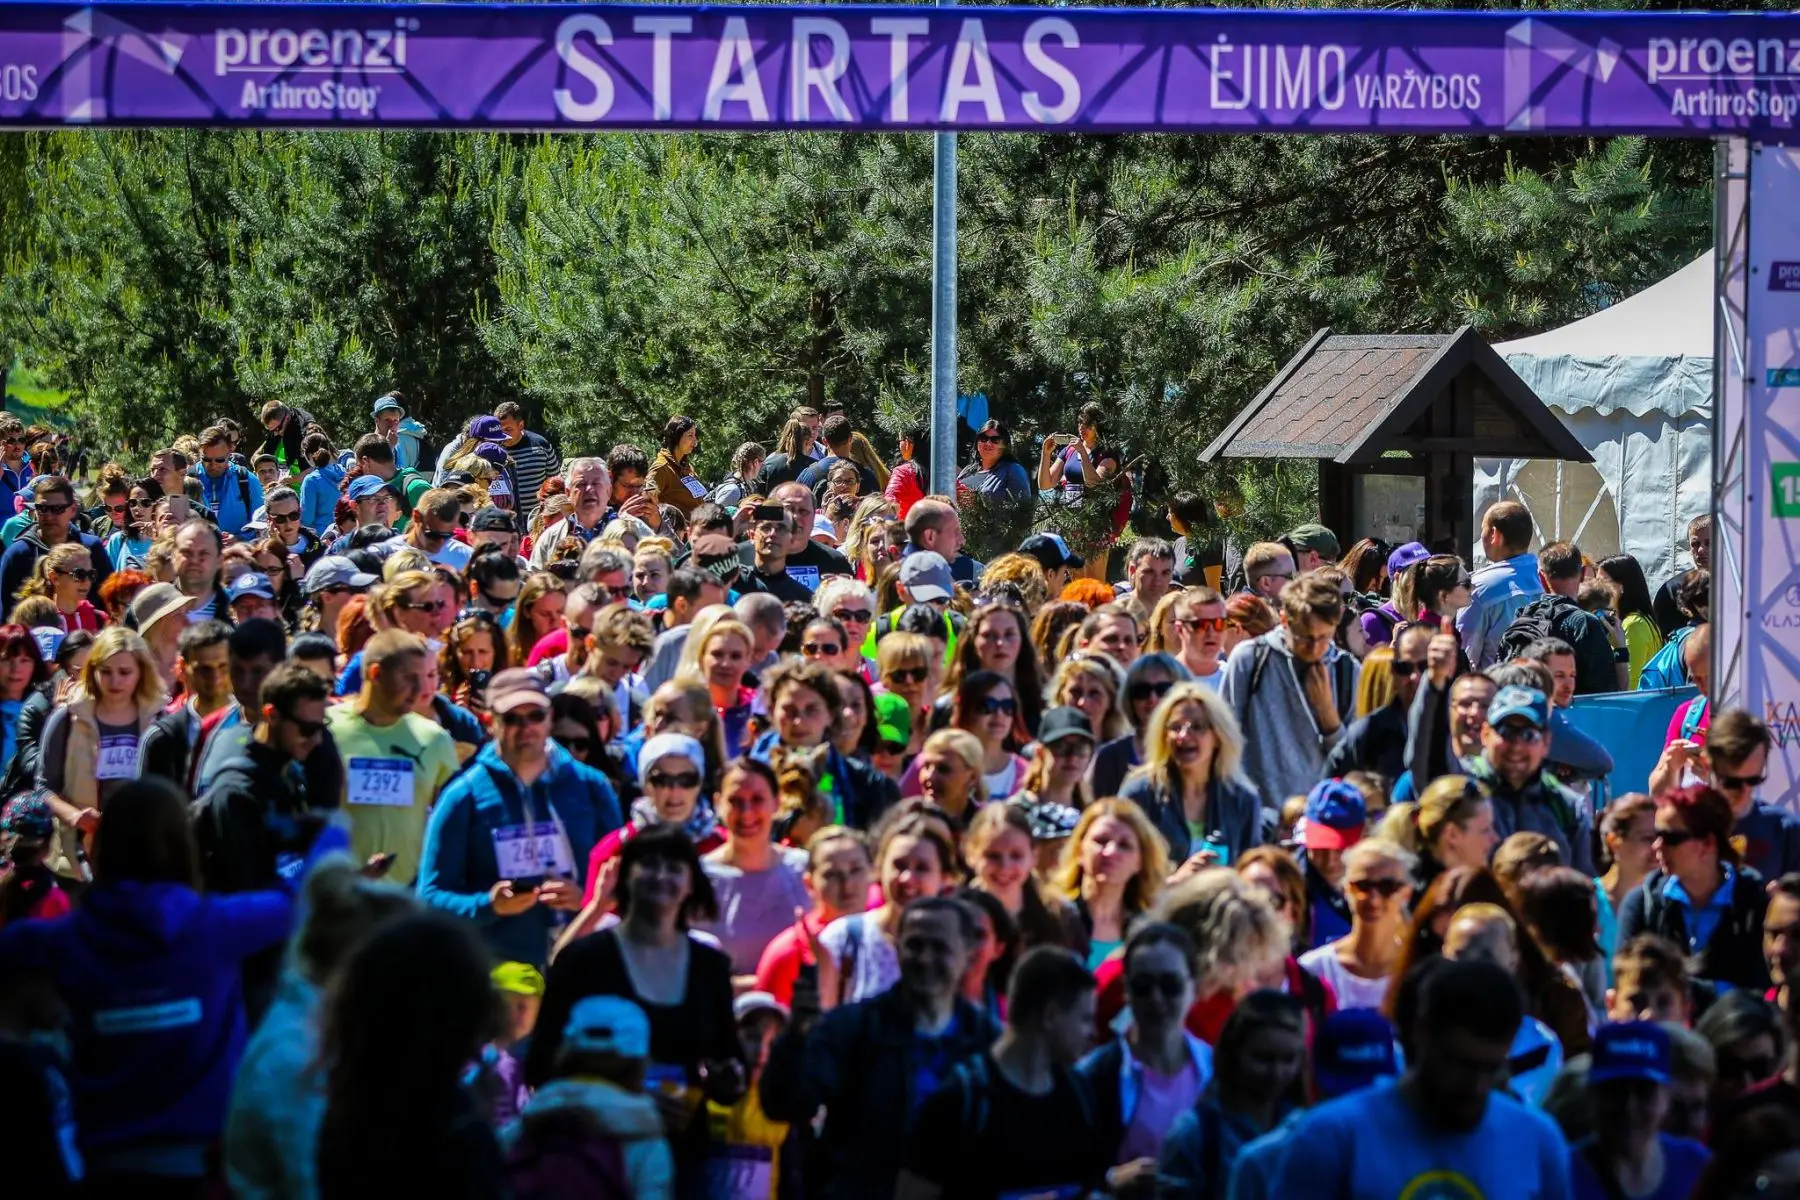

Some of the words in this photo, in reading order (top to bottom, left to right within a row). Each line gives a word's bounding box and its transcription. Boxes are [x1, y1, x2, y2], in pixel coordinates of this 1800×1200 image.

[215, 17, 406, 76] proenzi
[0, 64, 38, 101] OS
[553, 13, 1082, 123] STARTAS
[1210, 33, 1346, 111] ĖJIMO
[1354, 68, 1482, 110] VARŽYBOS
[240, 79, 377, 116] ArthroStop
[1671, 87, 1798, 122] ArthroStop
[361, 771, 402, 793] 2392
